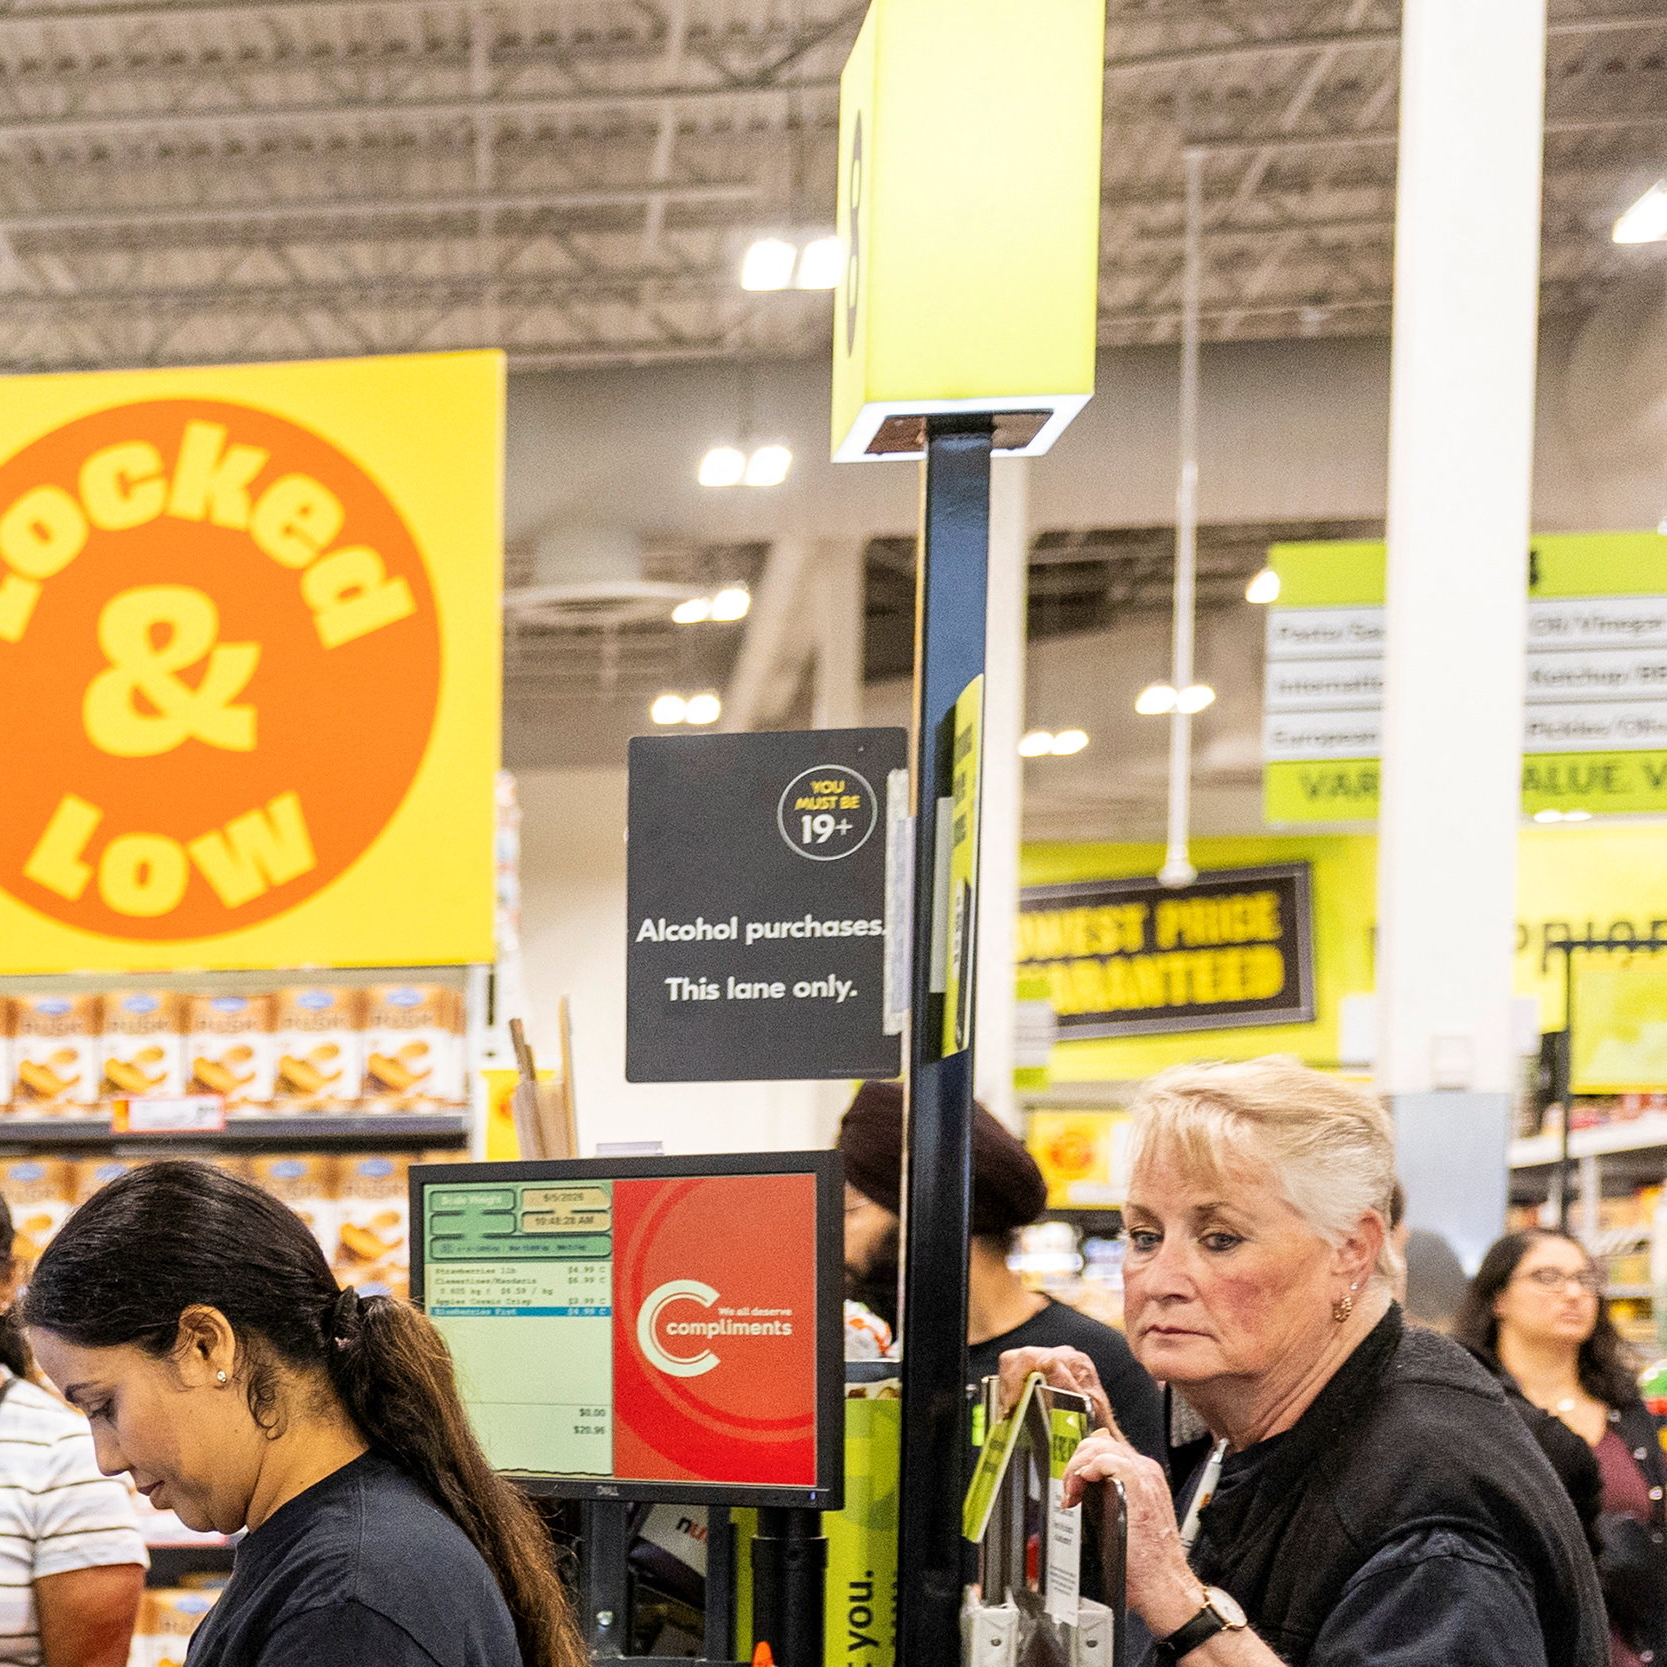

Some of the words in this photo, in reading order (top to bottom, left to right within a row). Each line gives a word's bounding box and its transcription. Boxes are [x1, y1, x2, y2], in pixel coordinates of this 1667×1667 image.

[81, 582, 264, 758] &
[794, 796, 838, 811] MUST
[840, 795, 861, 809] BE
[809, 780, 845, 794] YOU
[800, 812, 854, 844] 19+
[635, 916, 739, 943] Alcohol
[745, 914, 887, 946] purchases.
[664, 975, 721, 1002] This
[726, 975, 786, 1000] lane
[792, 972, 858, 1004] only.
[666, 1318, 793, 1340] compliments
[847, 1570, 879, 1652] you.
